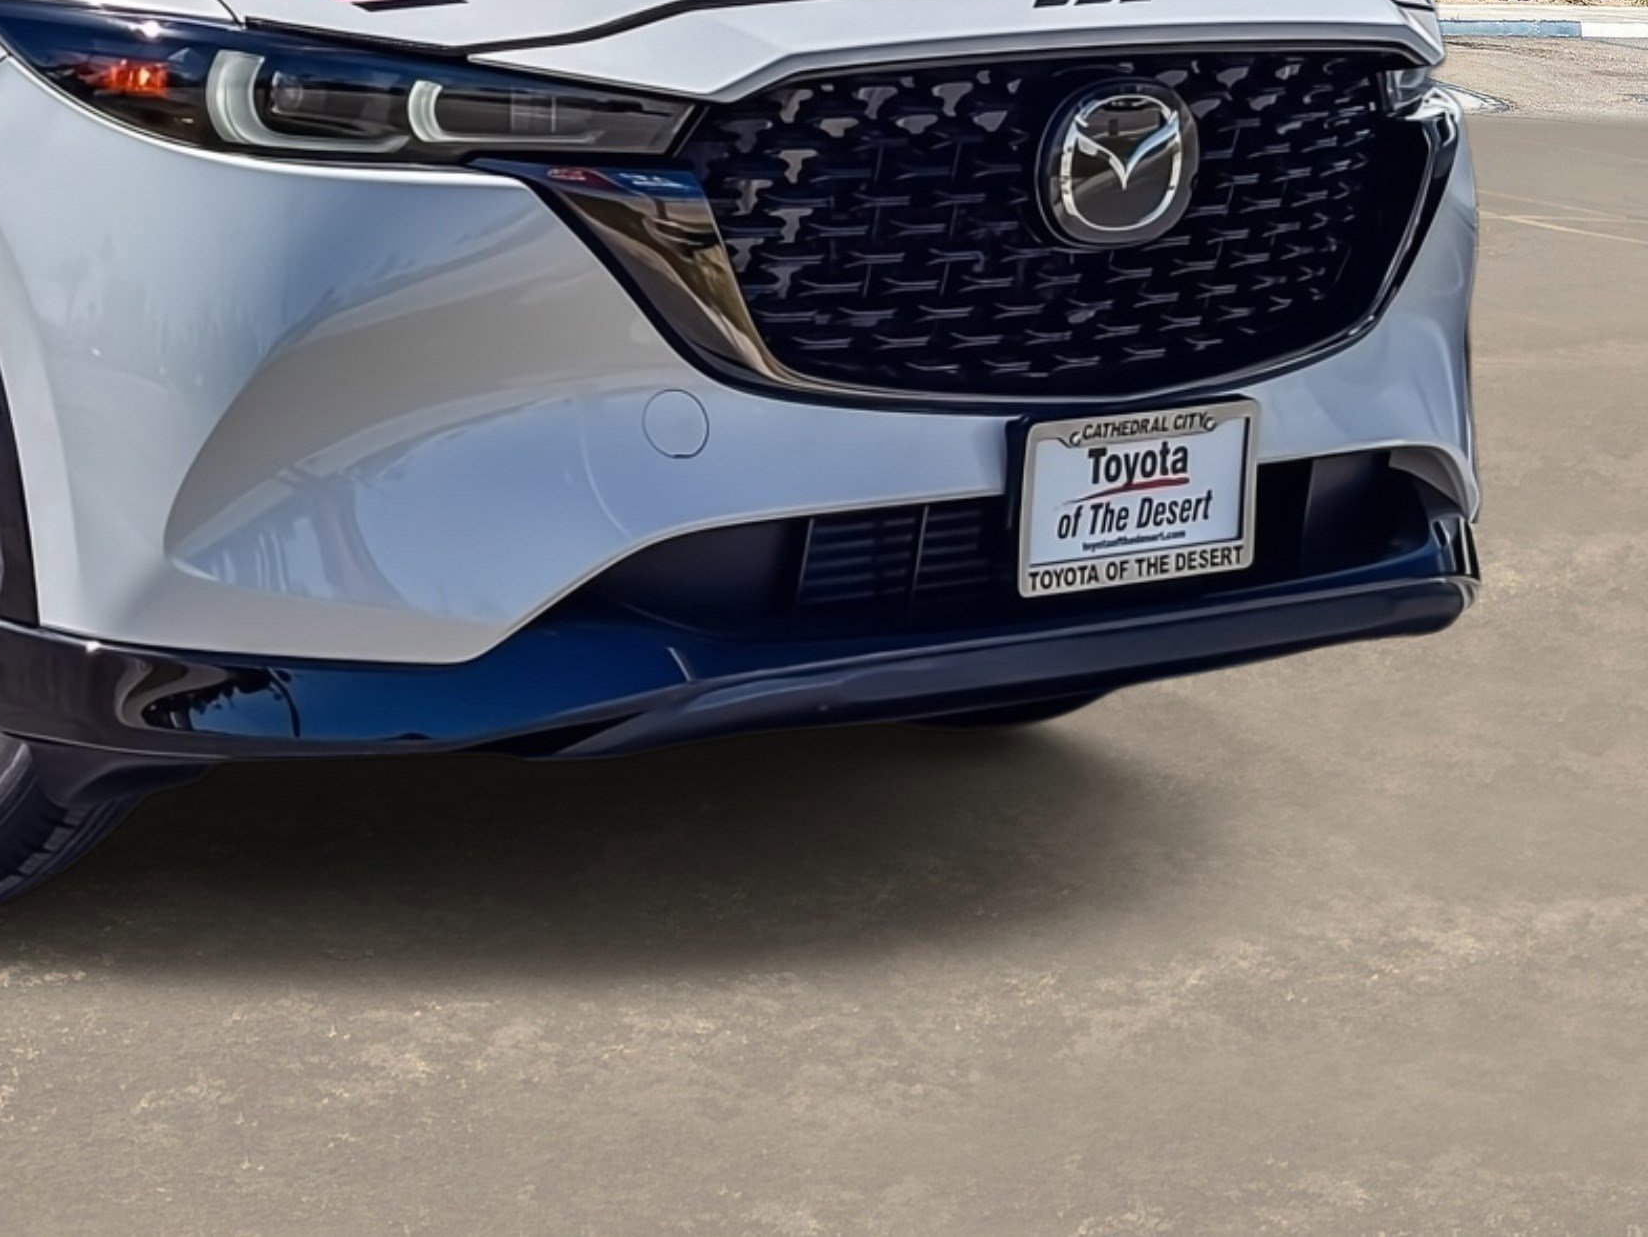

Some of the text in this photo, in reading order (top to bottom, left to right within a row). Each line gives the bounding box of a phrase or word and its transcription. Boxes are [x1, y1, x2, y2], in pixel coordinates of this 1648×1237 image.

[1082, 412, 1209, 440] CATHEDRAL CITY
[1088, 441, 1189, 486] Toyota
[1057, 489, 1213, 539] of The Desert
[1028, 544, 1244, 591] TOYOTA OF THE DESERT
